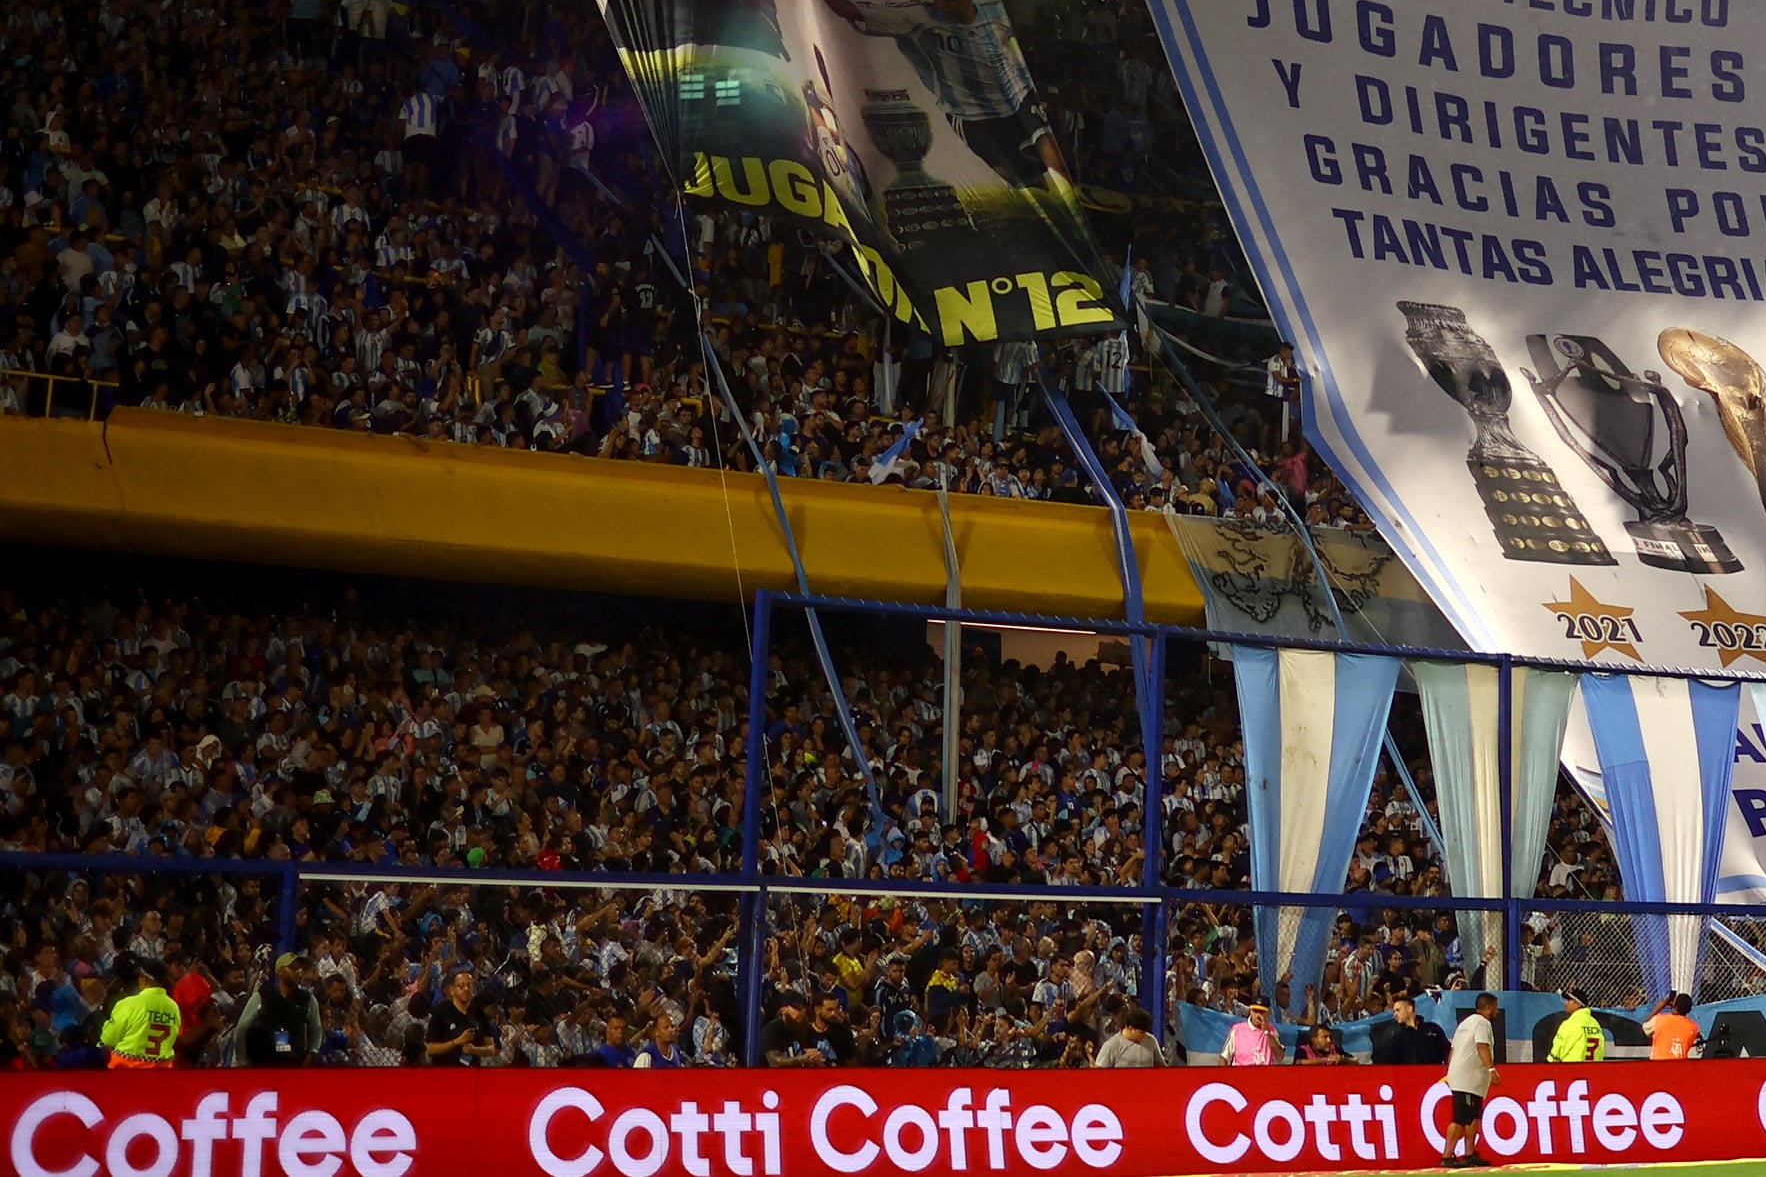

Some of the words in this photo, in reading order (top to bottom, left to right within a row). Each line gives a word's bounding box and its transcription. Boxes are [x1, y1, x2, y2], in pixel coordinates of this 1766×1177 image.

[1272, 59, 1303, 110] Y
[1304, 133, 1616, 229] GRACIAS
[684, 151, 931, 335] JUGA
[932, 270, 1115, 347] N°12
[1332, 207, 1553, 287] TANTAS
[1106, 350, 1122, 369] 12
[1556, 613, 1643, 643] 2021
[147, 1010, 176, 1023] TECH
[12, 1091, 417, 1177] Coffee
[530, 1087, 781, 1177] Cotti
[811, 1085, 1123, 1172] Coffee
[1186, 1083, 1396, 1163] Cotti
[1421, 1080, 1685, 1157] Coffee
